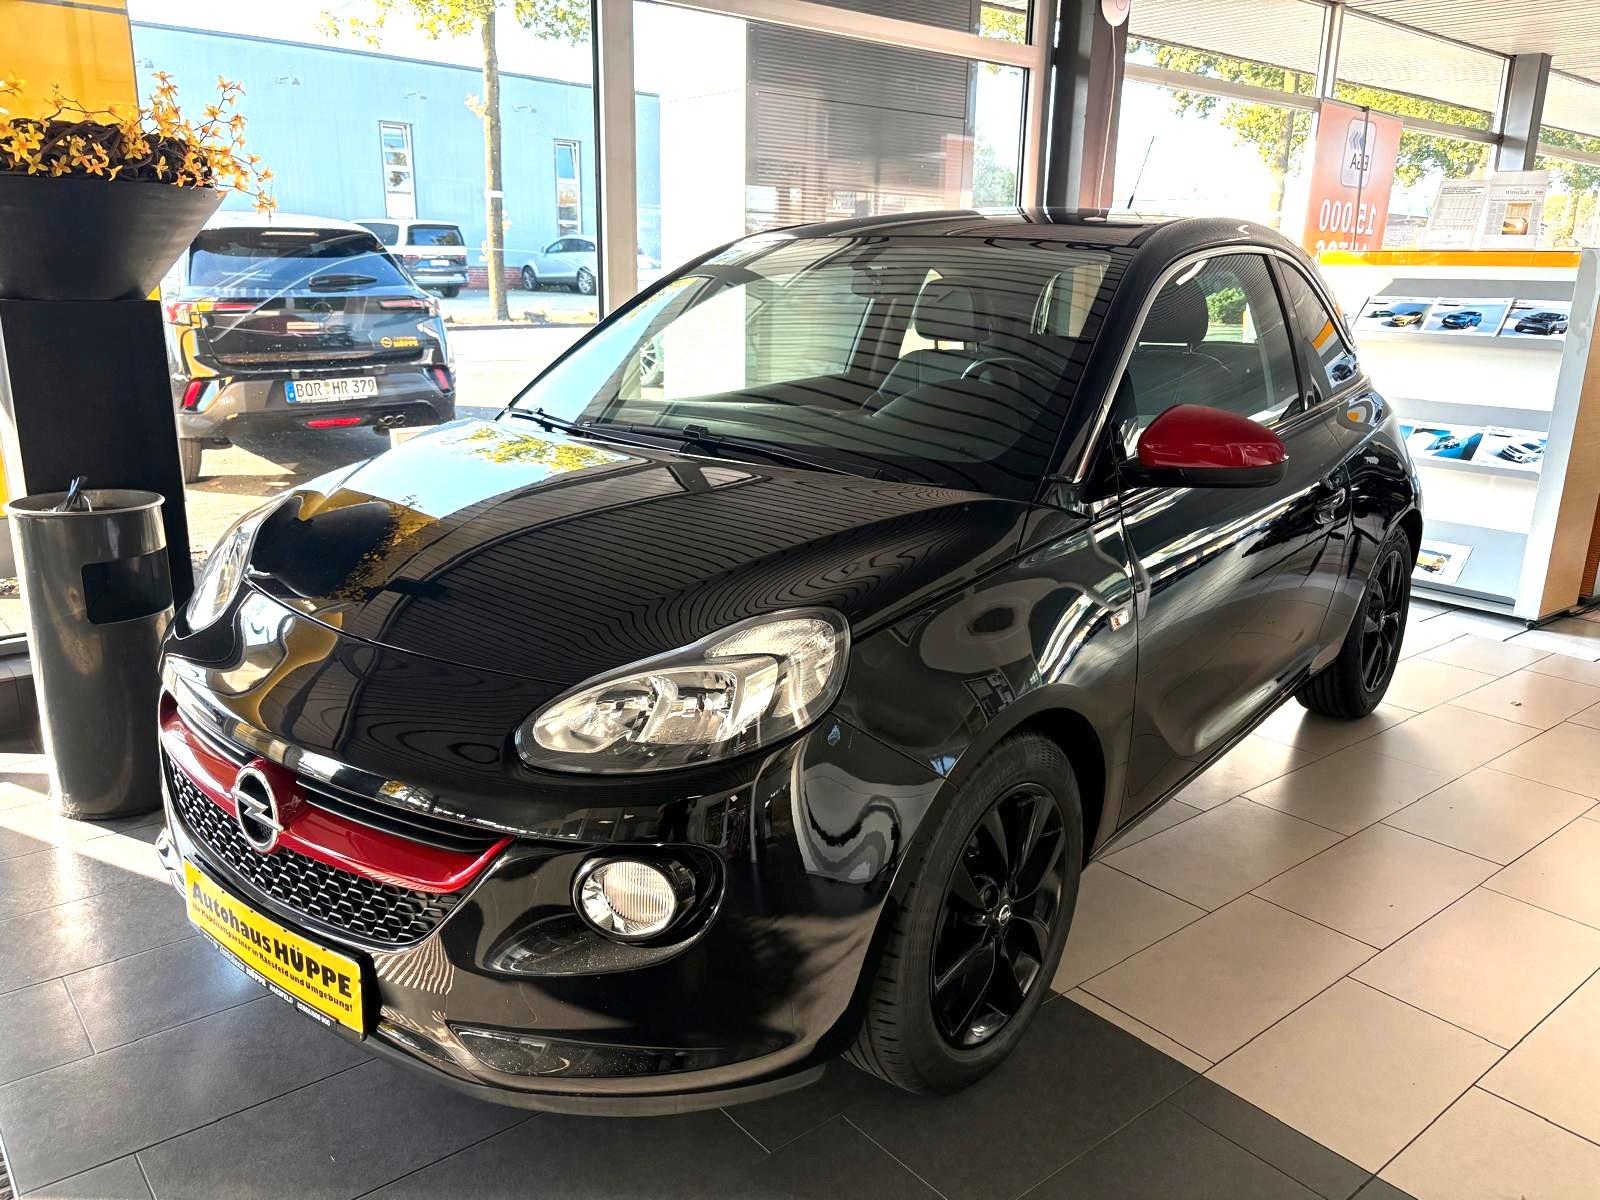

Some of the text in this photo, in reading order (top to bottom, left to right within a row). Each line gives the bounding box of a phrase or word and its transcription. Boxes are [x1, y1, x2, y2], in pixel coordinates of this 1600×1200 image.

[295, 379, 375, 398] BOR HR 379
[258, 952, 289, 977] Raesfeld
[289, 974, 305, 987] und
[305, 982, 353, 1013] Umgebung!
